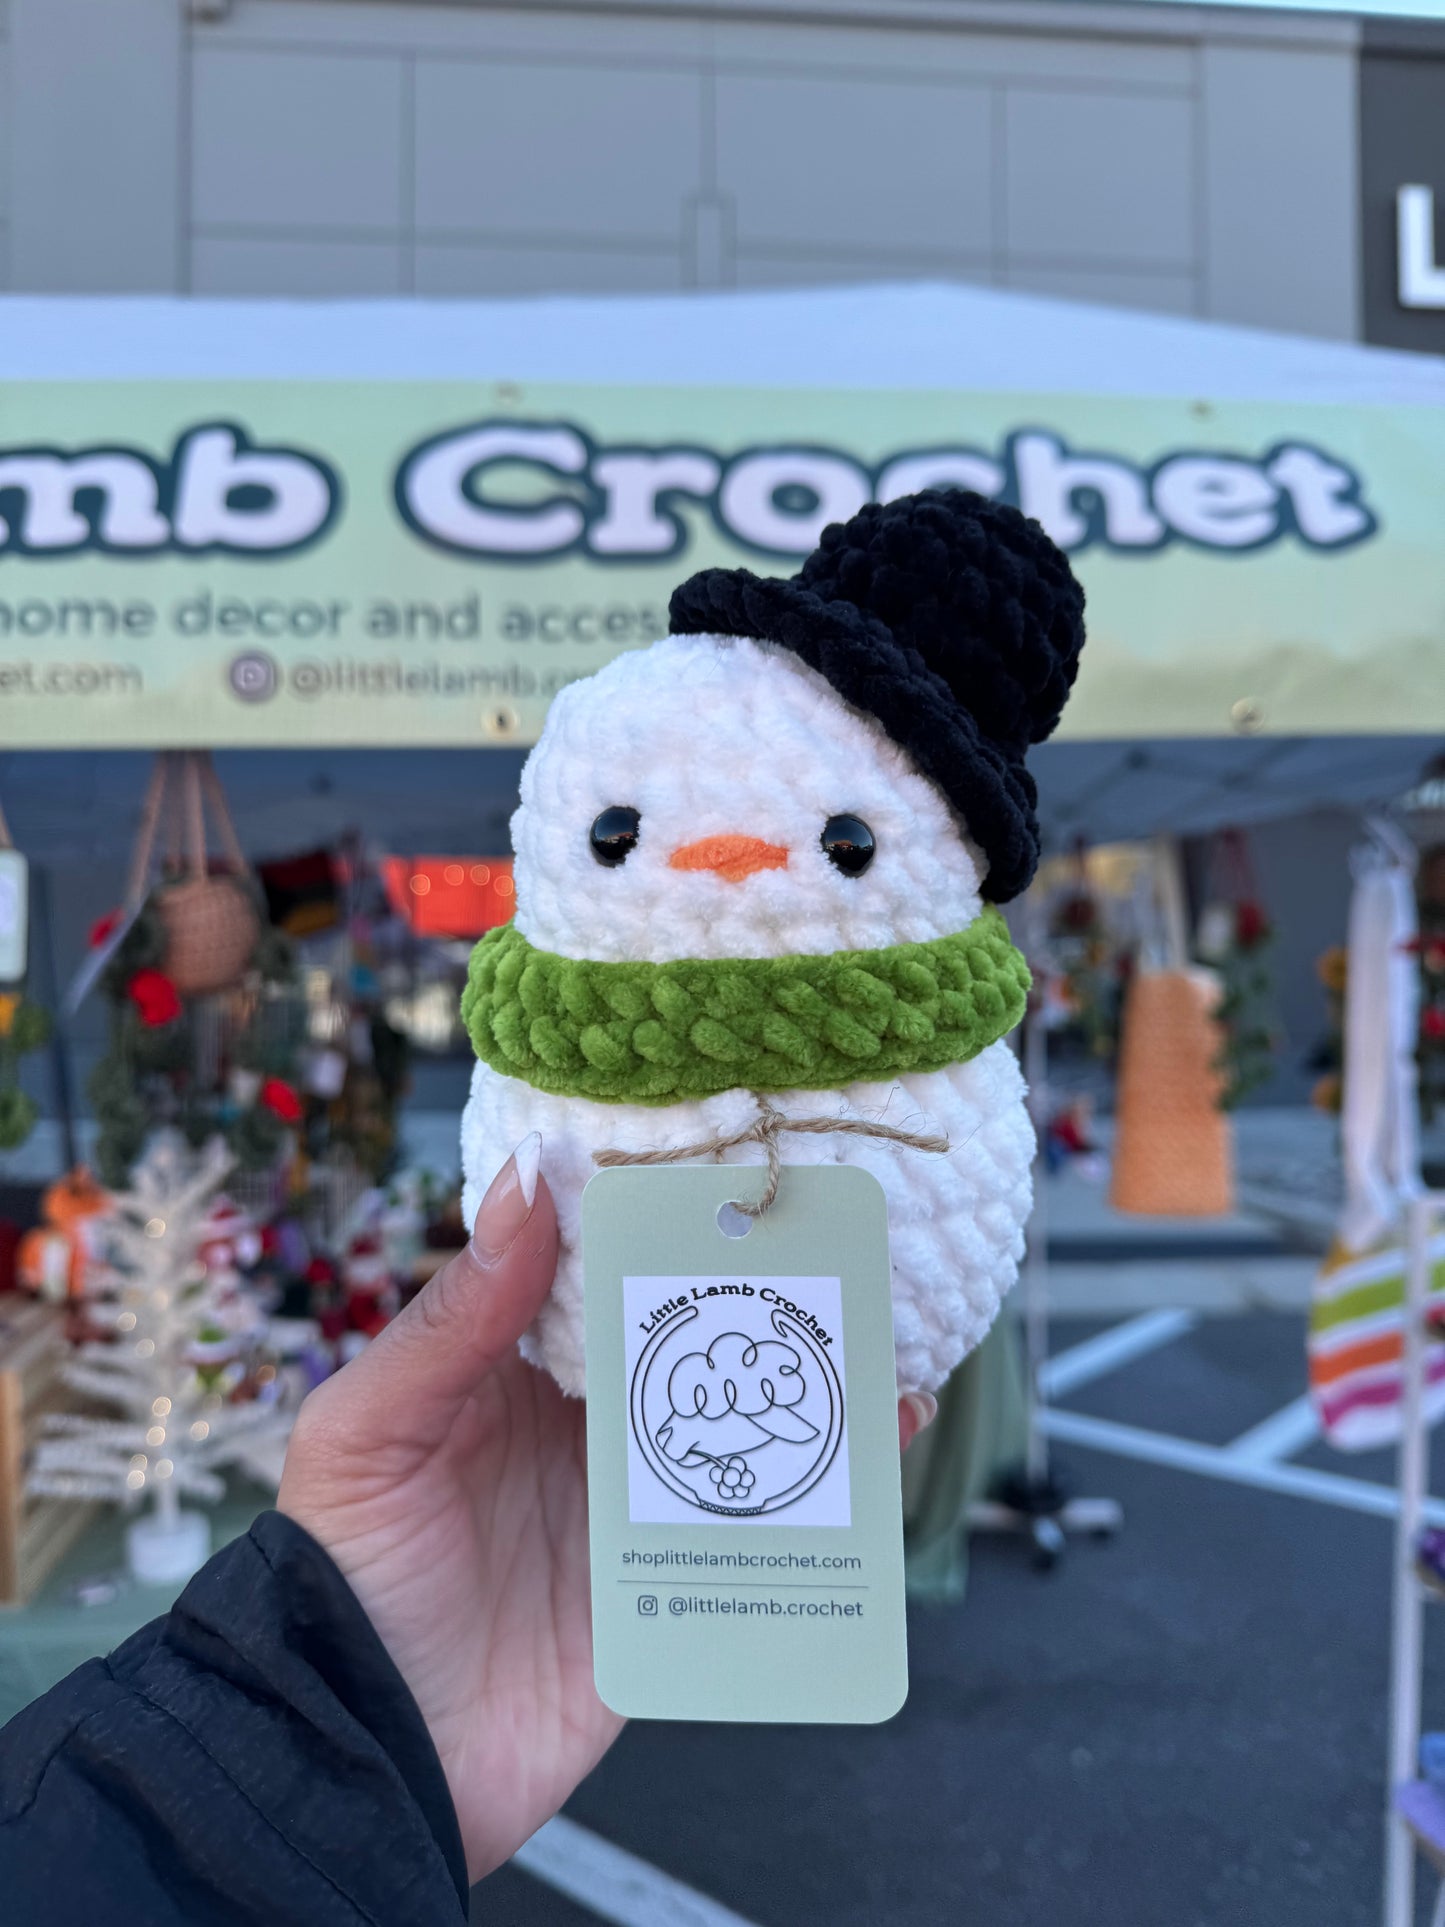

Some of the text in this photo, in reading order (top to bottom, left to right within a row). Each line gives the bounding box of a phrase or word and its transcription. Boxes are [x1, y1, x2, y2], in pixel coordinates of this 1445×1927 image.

[174, 588, 348, 637] decor
[368, 590, 480, 641] and
[500, 602, 667, 644] acces
[639, 1283, 833, 1347] Little Lamb Crochet
[622, 1549, 862, 1569] shoplittlelambcrochet.com
[668, 1596, 864, 1617] @littlelamb.crochet
